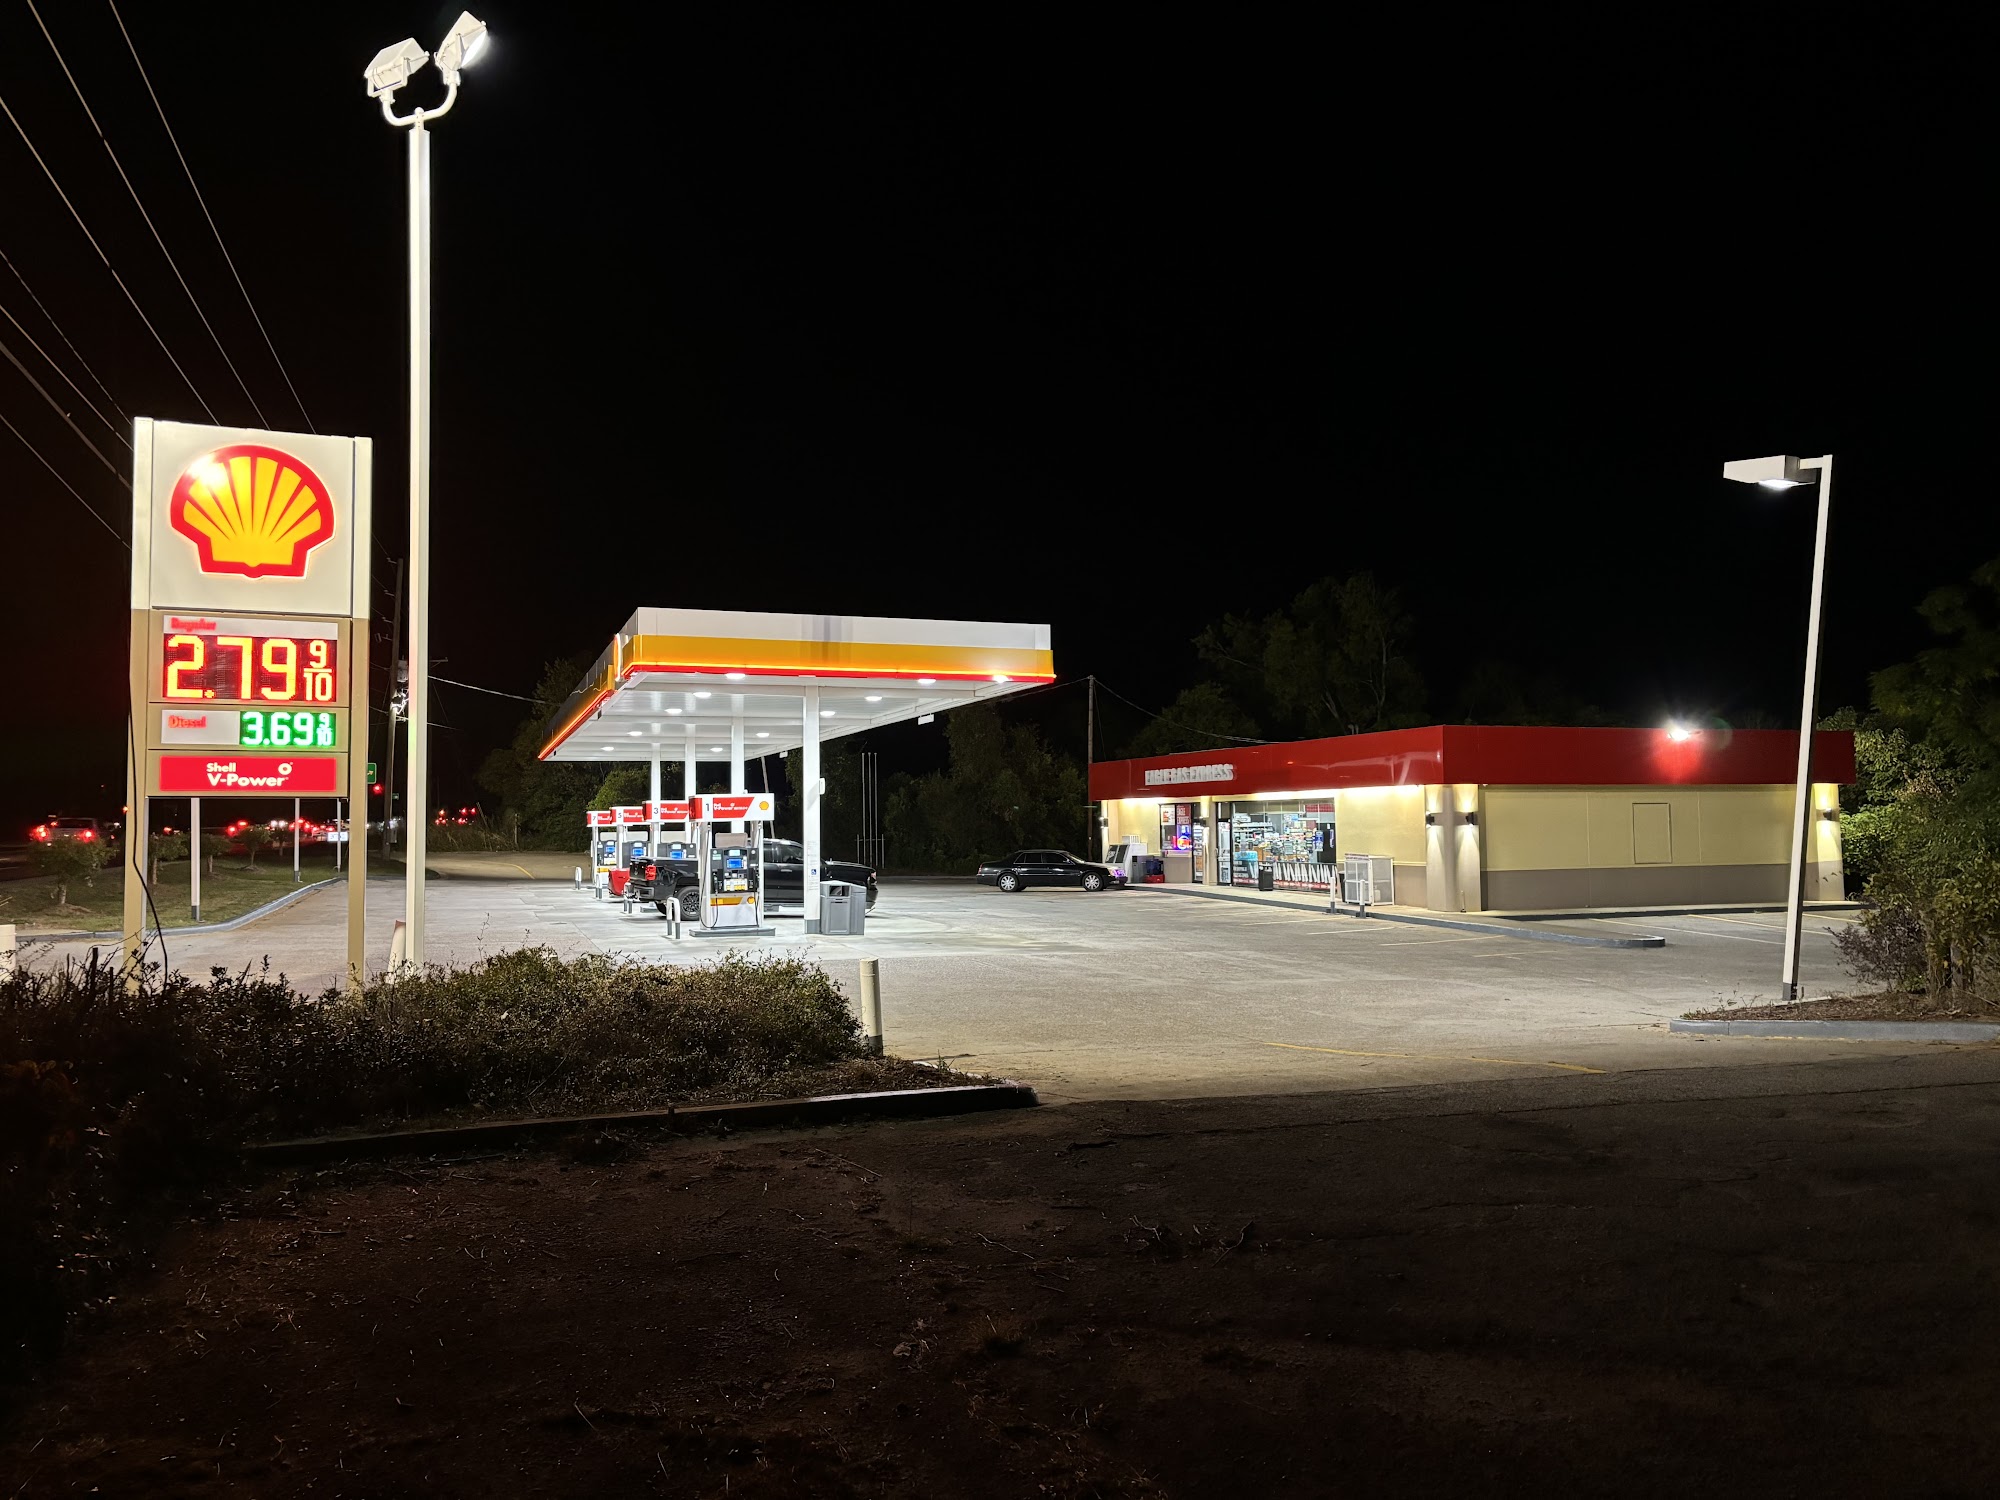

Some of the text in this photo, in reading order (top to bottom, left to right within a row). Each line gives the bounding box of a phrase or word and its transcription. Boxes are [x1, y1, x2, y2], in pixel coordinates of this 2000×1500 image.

[171, 617, 216, 632] Regular
[167, 634, 297, 701] 2.79
[168, 714, 207, 728] Diesel
[242, 711, 315, 746] 3.69
[206, 762, 236, 772] Shell
[207, 774, 284, 787] V-Power
[705, 803, 710, 811] 1
